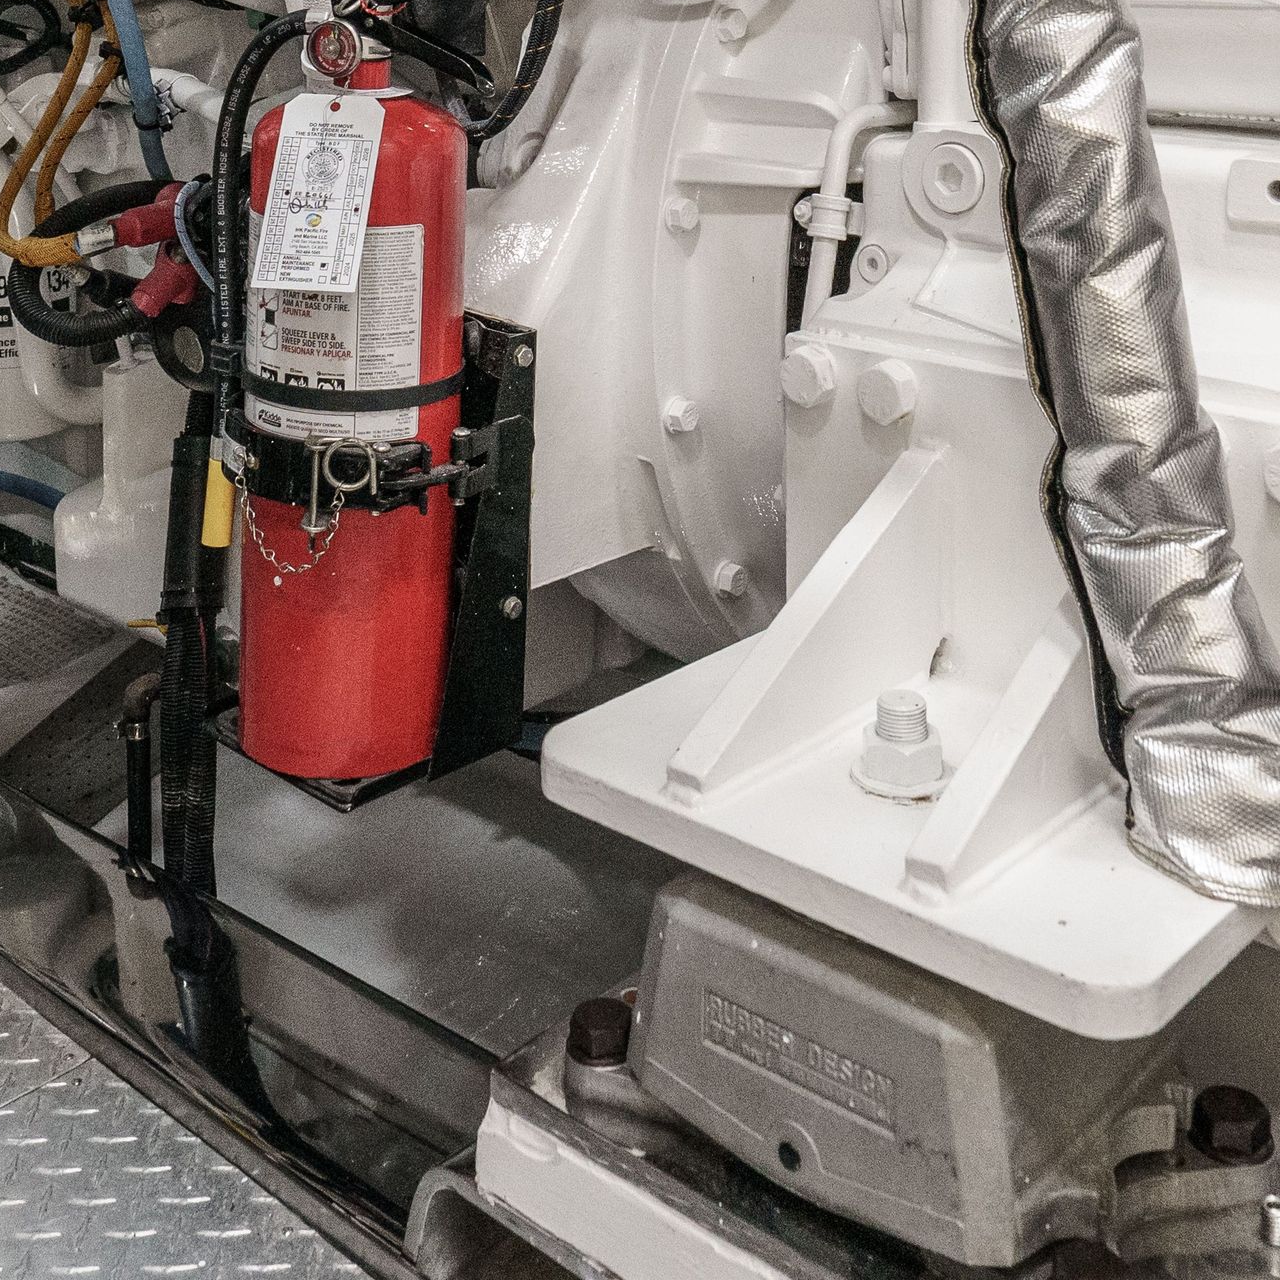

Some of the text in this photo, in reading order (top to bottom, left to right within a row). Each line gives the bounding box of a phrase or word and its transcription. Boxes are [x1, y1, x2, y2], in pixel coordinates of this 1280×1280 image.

[227, 87, 241, 111] ISSUE
[219, 152, 228, 175] HOSE
[217, 178, 226, 215] BOOSTER
[218, 231, 226, 253] EXT.
[219, 257, 227, 280] FIRE
[220, 283, 229, 318] LISTED
[282, 290, 344, 303] START 8 FEET.
[282, 298, 350, 312] AIM AT BASE OF FIRE.
[281, 327, 308, 338] SQUEEZE
[308, 332, 329, 340] LEVER
[281, 336, 301, 345] SWEEP
[302, 339, 317, 348] SIDE
[329, 341, 346, 350] SIDE.
[281, 344, 353, 358] PRESIONAR Y APLICAR.
[707, 994, 794, 1060] RUBBER
[806, 1041, 893, 1099] DESIGN
